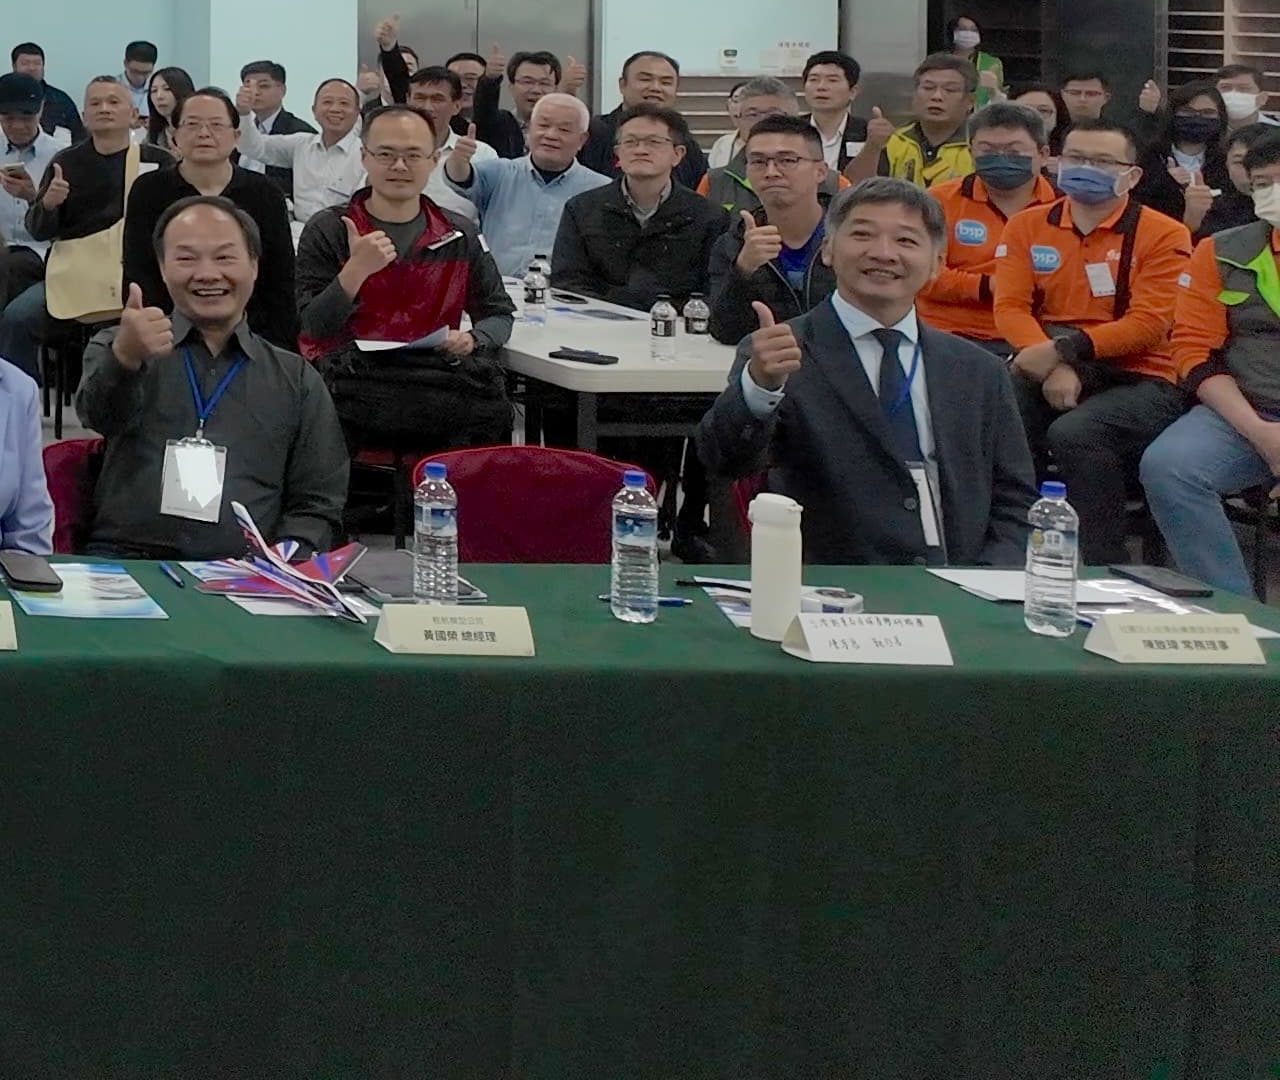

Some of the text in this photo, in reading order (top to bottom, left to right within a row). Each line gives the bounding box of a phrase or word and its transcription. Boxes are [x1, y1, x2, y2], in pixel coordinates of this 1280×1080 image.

[958, 223, 985, 239] bsp
[461, 630, 497, 643] 總經理
